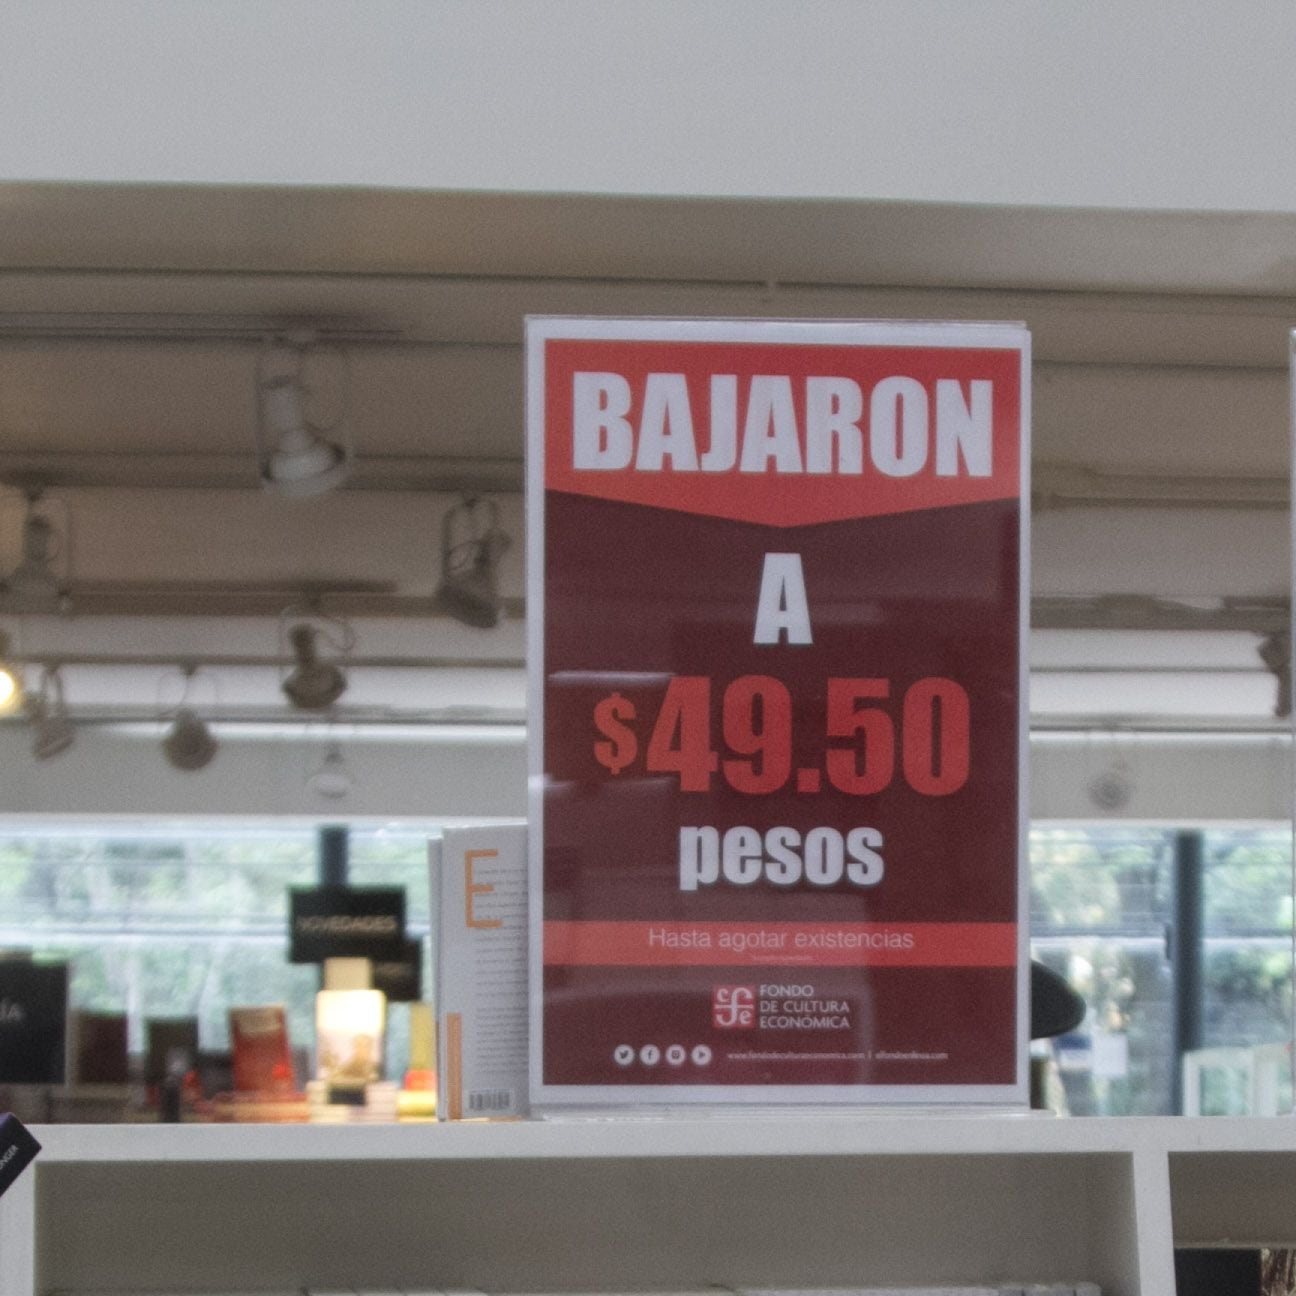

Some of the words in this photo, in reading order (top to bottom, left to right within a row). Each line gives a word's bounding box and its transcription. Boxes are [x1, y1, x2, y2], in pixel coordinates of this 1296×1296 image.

[572, 370, 994, 478] BAJARON
[752, 552, 814, 646] A
[592, 674, 971, 796] $49.50
[678, 825, 885, 891] pesos
[648, 928, 712, 948] Hasta
[718, 929, 788, 953] agotar
[794, 929, 915, 949] existencias
[759, 984, 815, 998] FONDO
[759, 1000, 779, 1013] DE
[783, 1000, 851, 1013] CULTURA
[759, 1014, 851, 1029] ECONÓMICA
